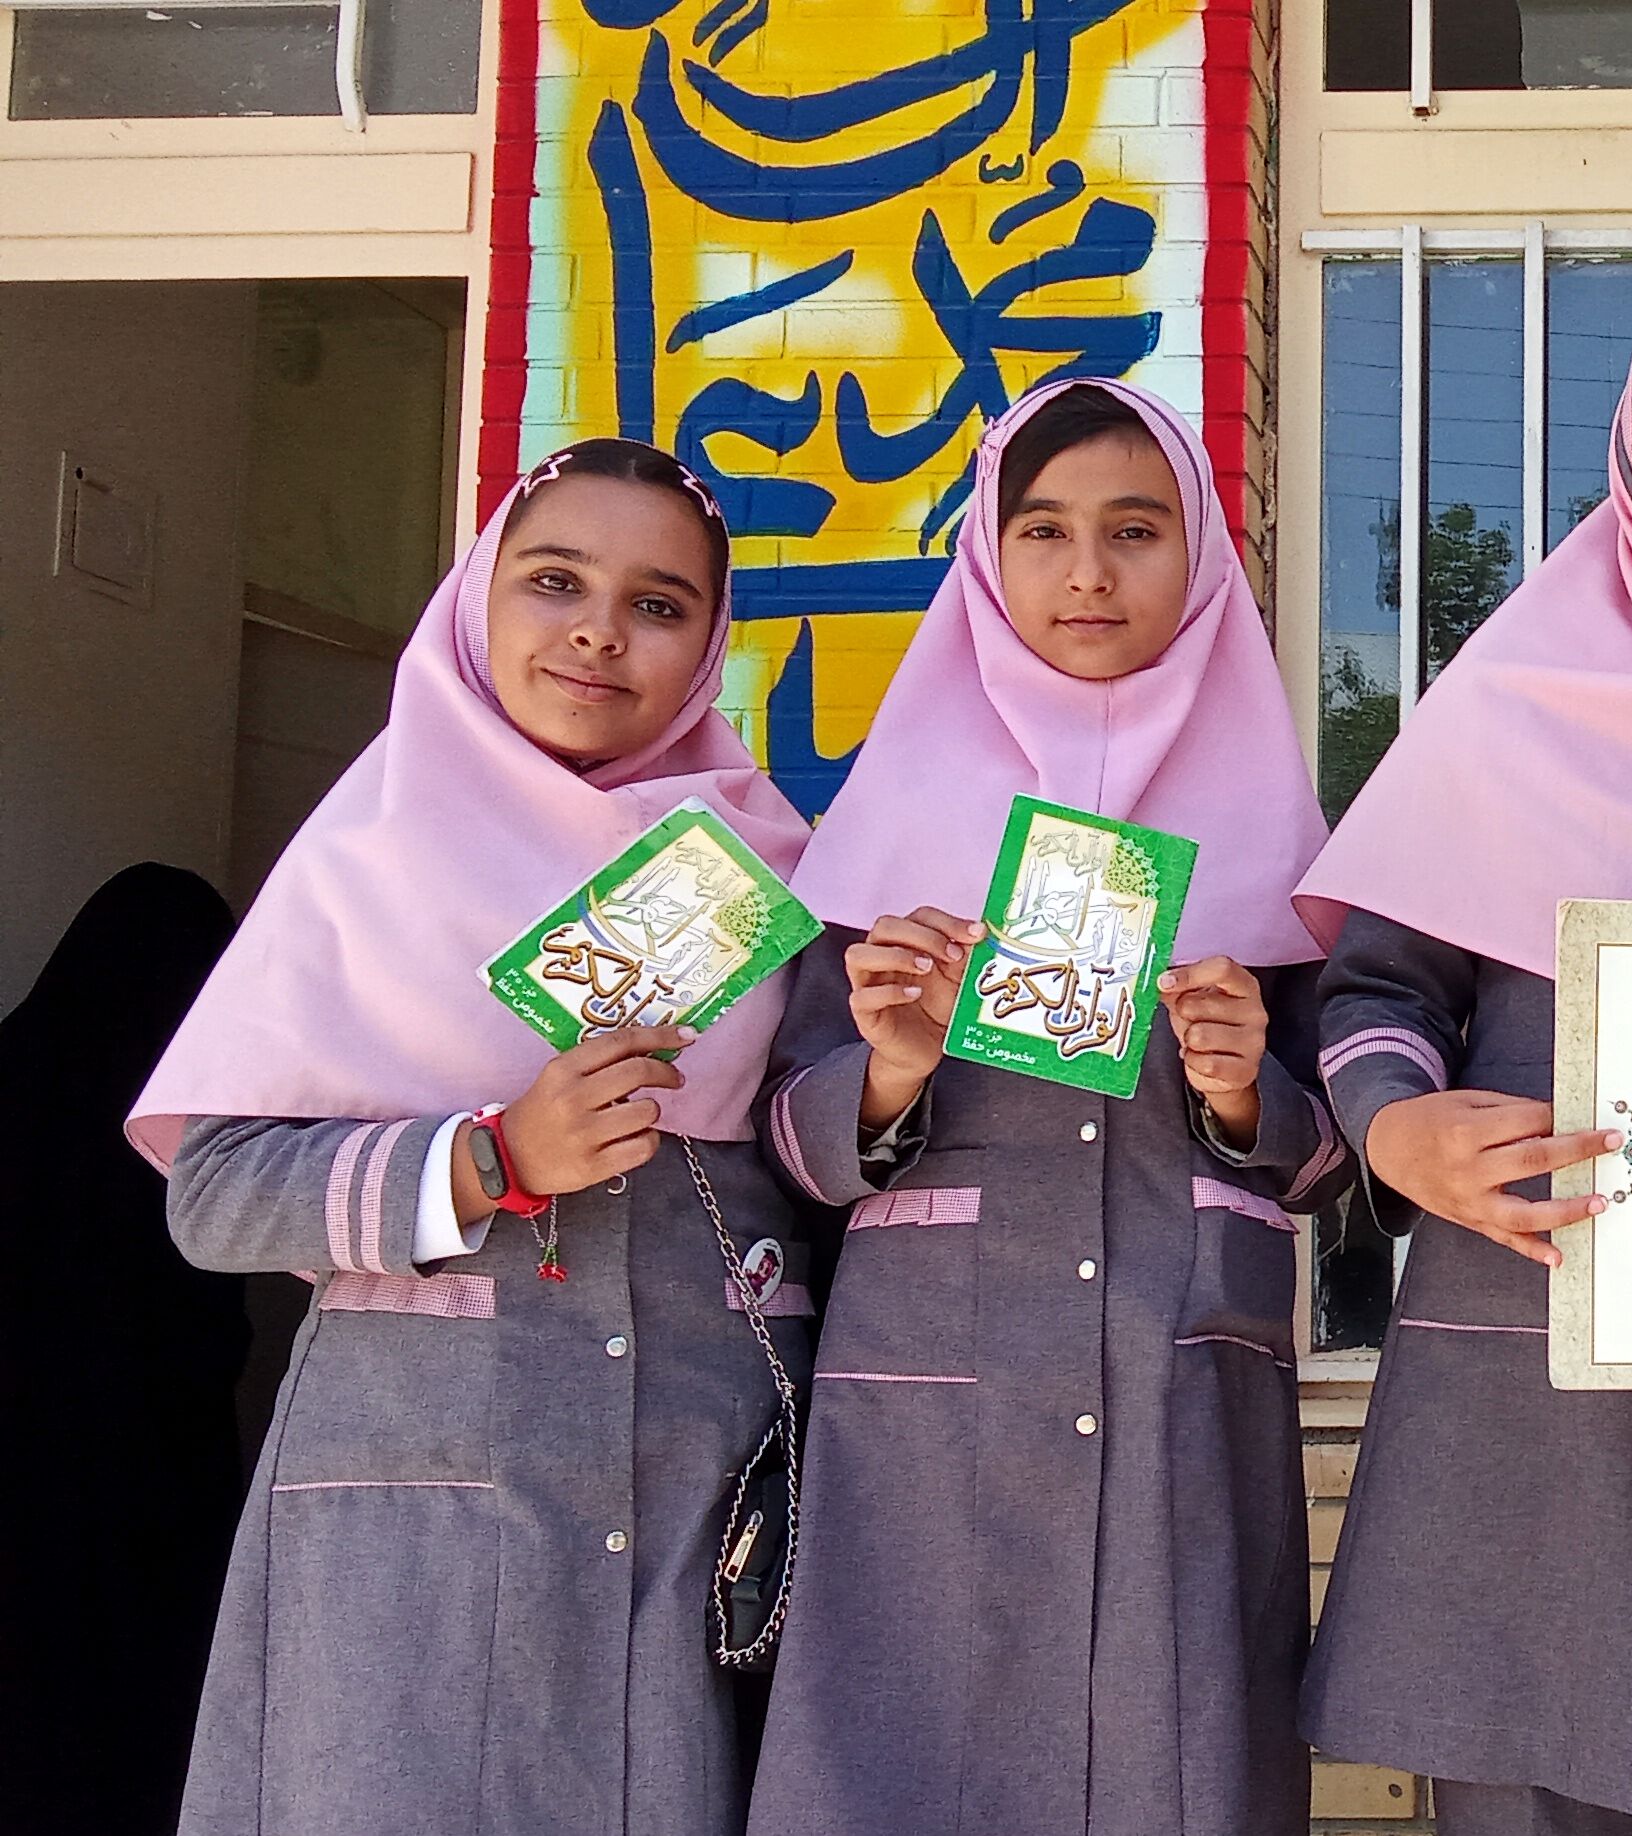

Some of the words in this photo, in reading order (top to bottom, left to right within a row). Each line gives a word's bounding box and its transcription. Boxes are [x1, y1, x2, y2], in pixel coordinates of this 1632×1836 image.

[495, 977, 516, 997] حفظ
[512, 997, 555, 1033] مخصوص
[961, 1037, 984, 1051] حفظ
[986, 1048, 1036, 1065] مخصوص
